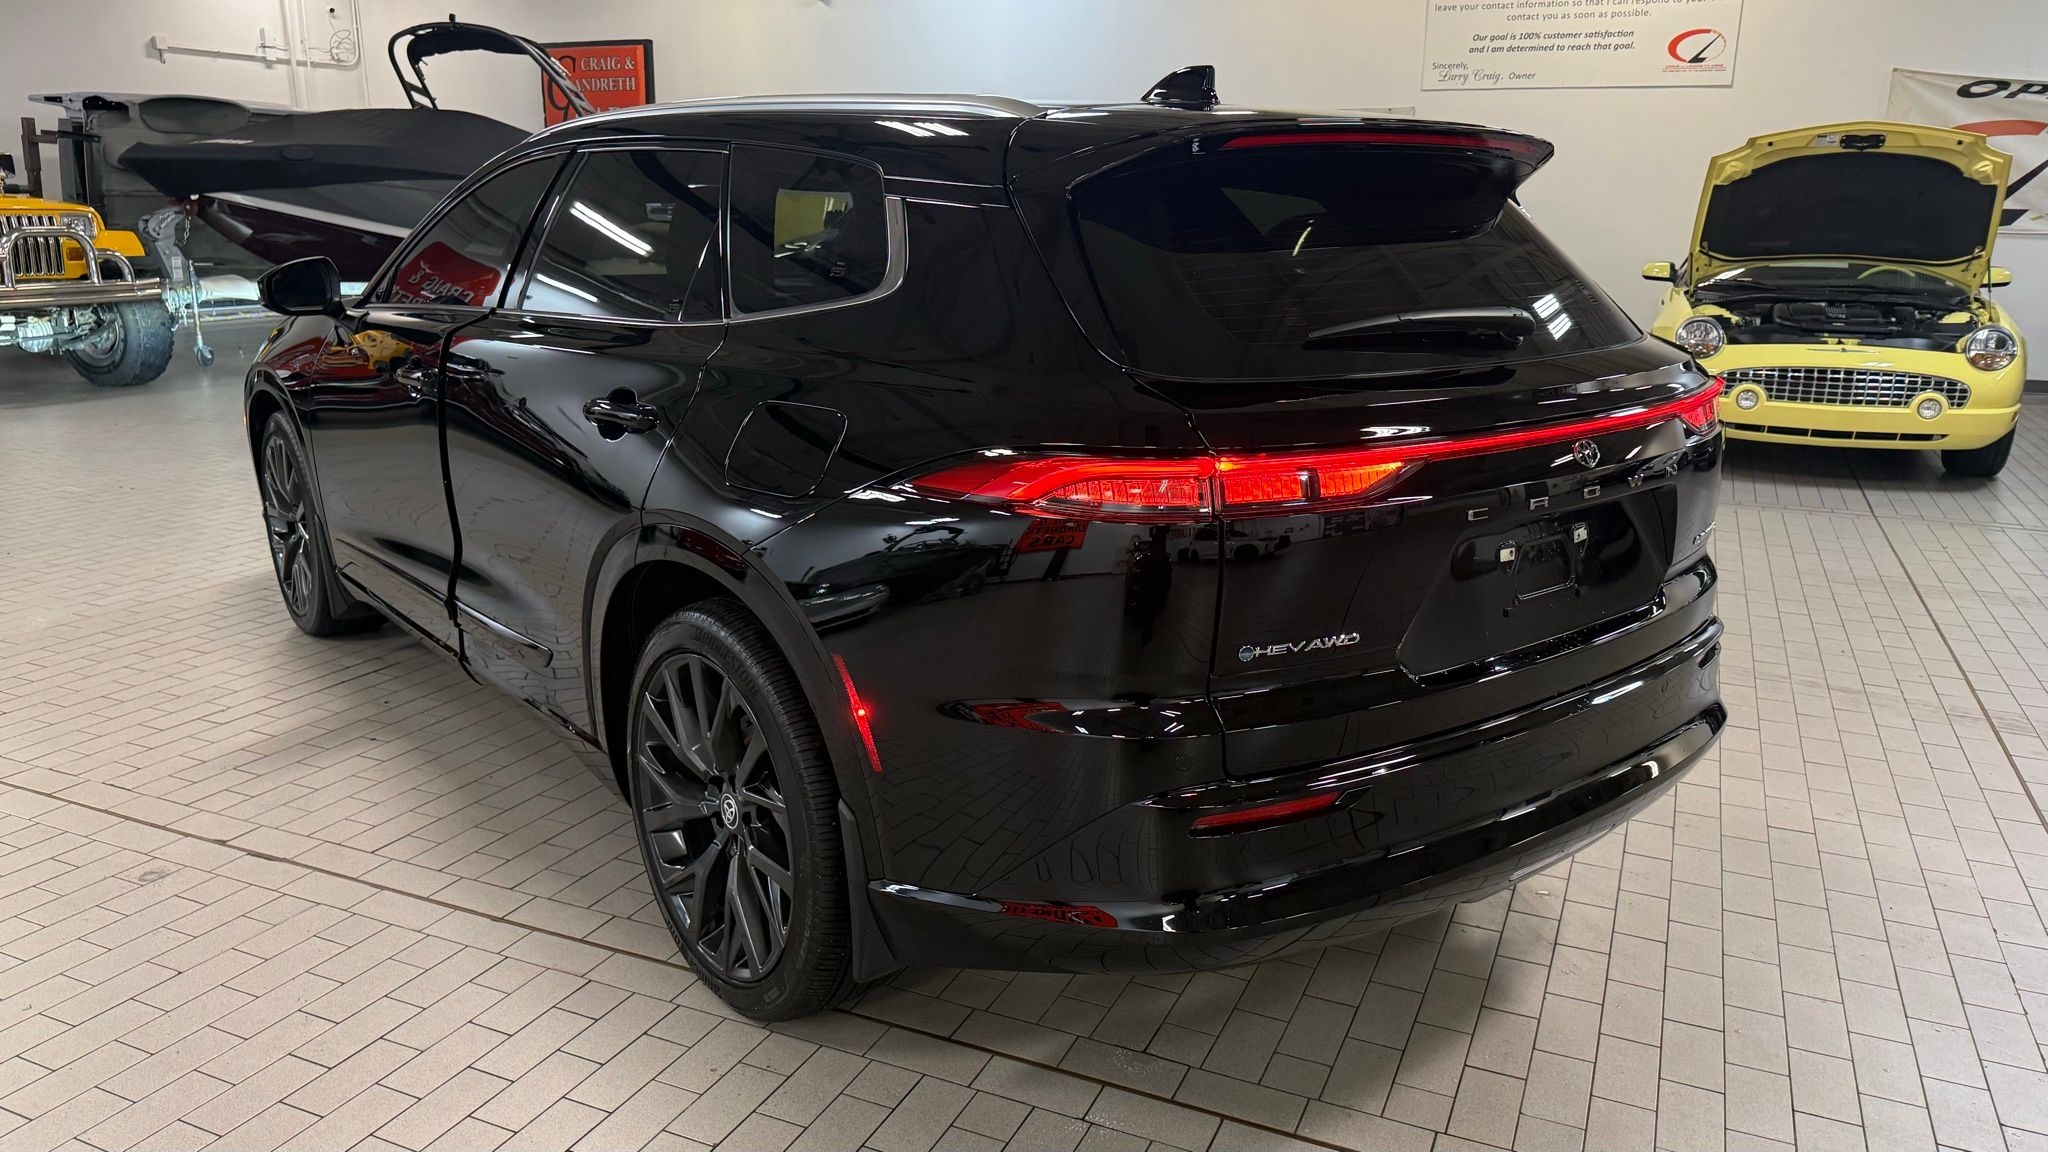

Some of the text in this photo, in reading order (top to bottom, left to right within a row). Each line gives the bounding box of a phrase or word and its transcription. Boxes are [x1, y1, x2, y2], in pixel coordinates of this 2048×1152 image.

[1434, 3, 1456, 12] leave
[1460, 5, 1479, 13] your
[1482, 2, 1514, 10] contact
[1517, 0, 1569, 9] information
[1507, 12, 1539, 21] contact
[1542, 13, 1558, 22] you
[1573, 11, 1595, 19] soon
[1611, 9, 1652, 20] possible.
[1472, 29, 1634, 43] Our goal is 100% customer satisfaction
[1469, 45, 1485, 54] and
[1506, 44, 1554, 53] determined
[1556, 43, 1565, 52] to
[1567, 42, 1591, 52] reach
[1593, 42, 1611, 51] that
[1613, 41, 1635, 52] goal.
[580, 56, 635, 72] CRAIG &
[1432, 61, 1469, 71] Sincerely,
[1438, 69, 1469, 85] Larry
[1508, 72, 1537, 80] Owner
[574, 77, 636, 92] ANDRETH
[1956, 79, 2048, 100] OP
[1467, 463, 1679, 522] CROWN
